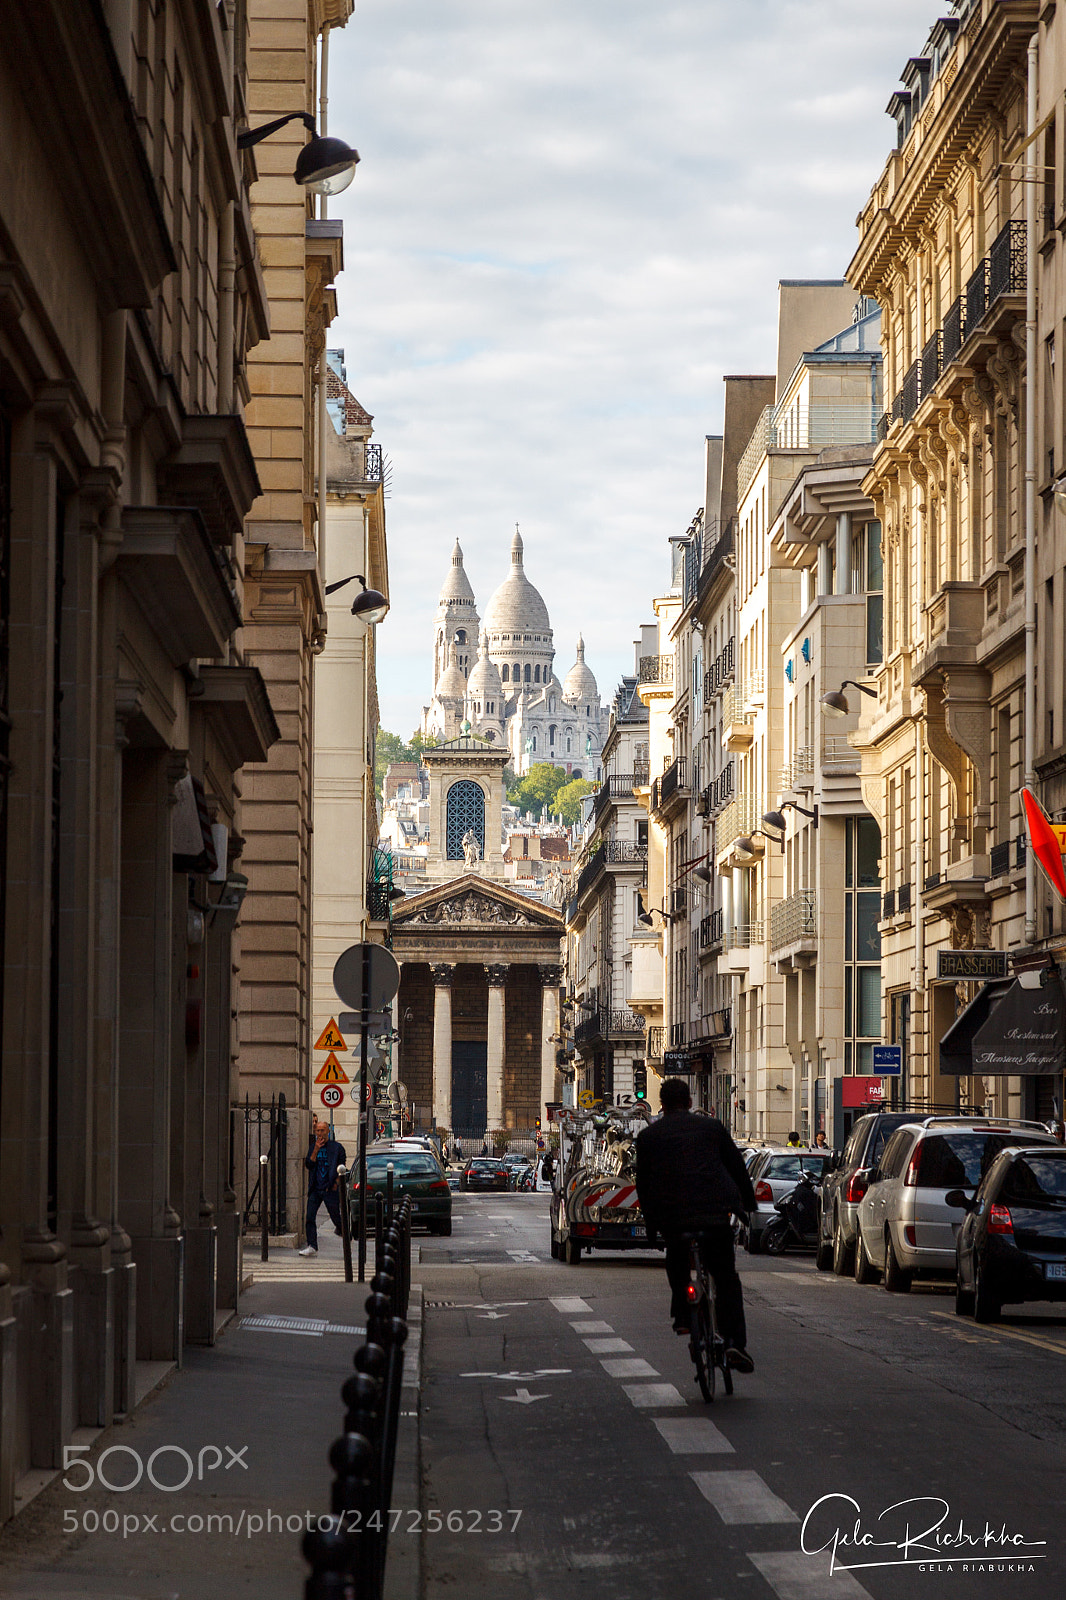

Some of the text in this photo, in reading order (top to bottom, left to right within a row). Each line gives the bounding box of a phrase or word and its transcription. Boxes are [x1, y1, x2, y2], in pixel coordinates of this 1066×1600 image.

[940, 956, 1004, 975] BRASSERIE
[1033, 1002, 1058, 1015] Bar
[1003, 1027, 1058, 1040] Restaurant
[975, 1052, 1023, 1064] Monsieur
[325, 1090, 339, 1102] 30
